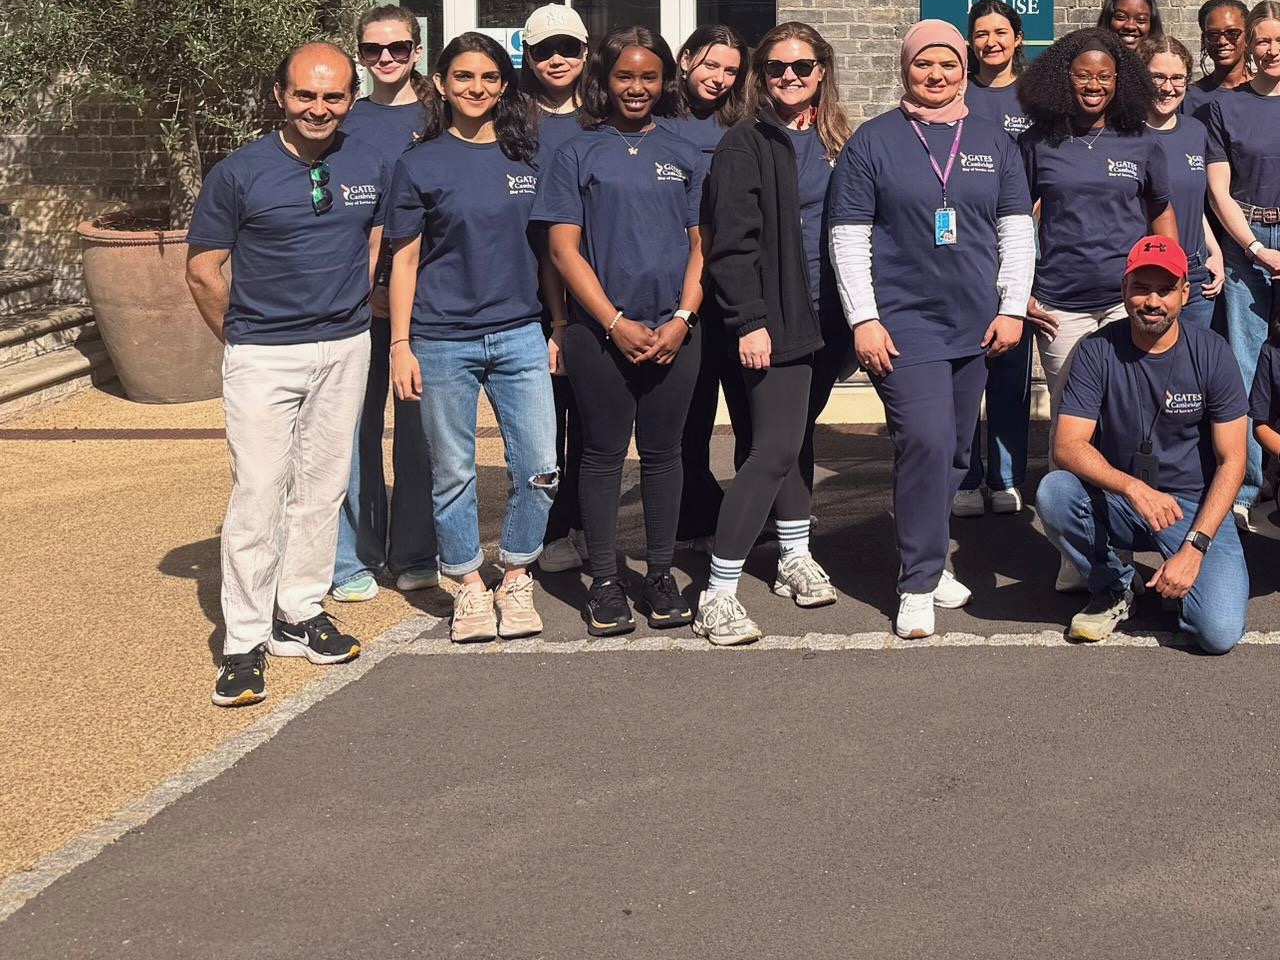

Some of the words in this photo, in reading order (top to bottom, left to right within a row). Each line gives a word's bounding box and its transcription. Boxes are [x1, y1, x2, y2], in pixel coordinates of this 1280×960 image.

[967, 154, 993, 163] GATES
[350, 184, 376, 194] GATES
[1173, 393, 1203, 402] GATES
[1170, 401, 1202, 409] Cambridge
